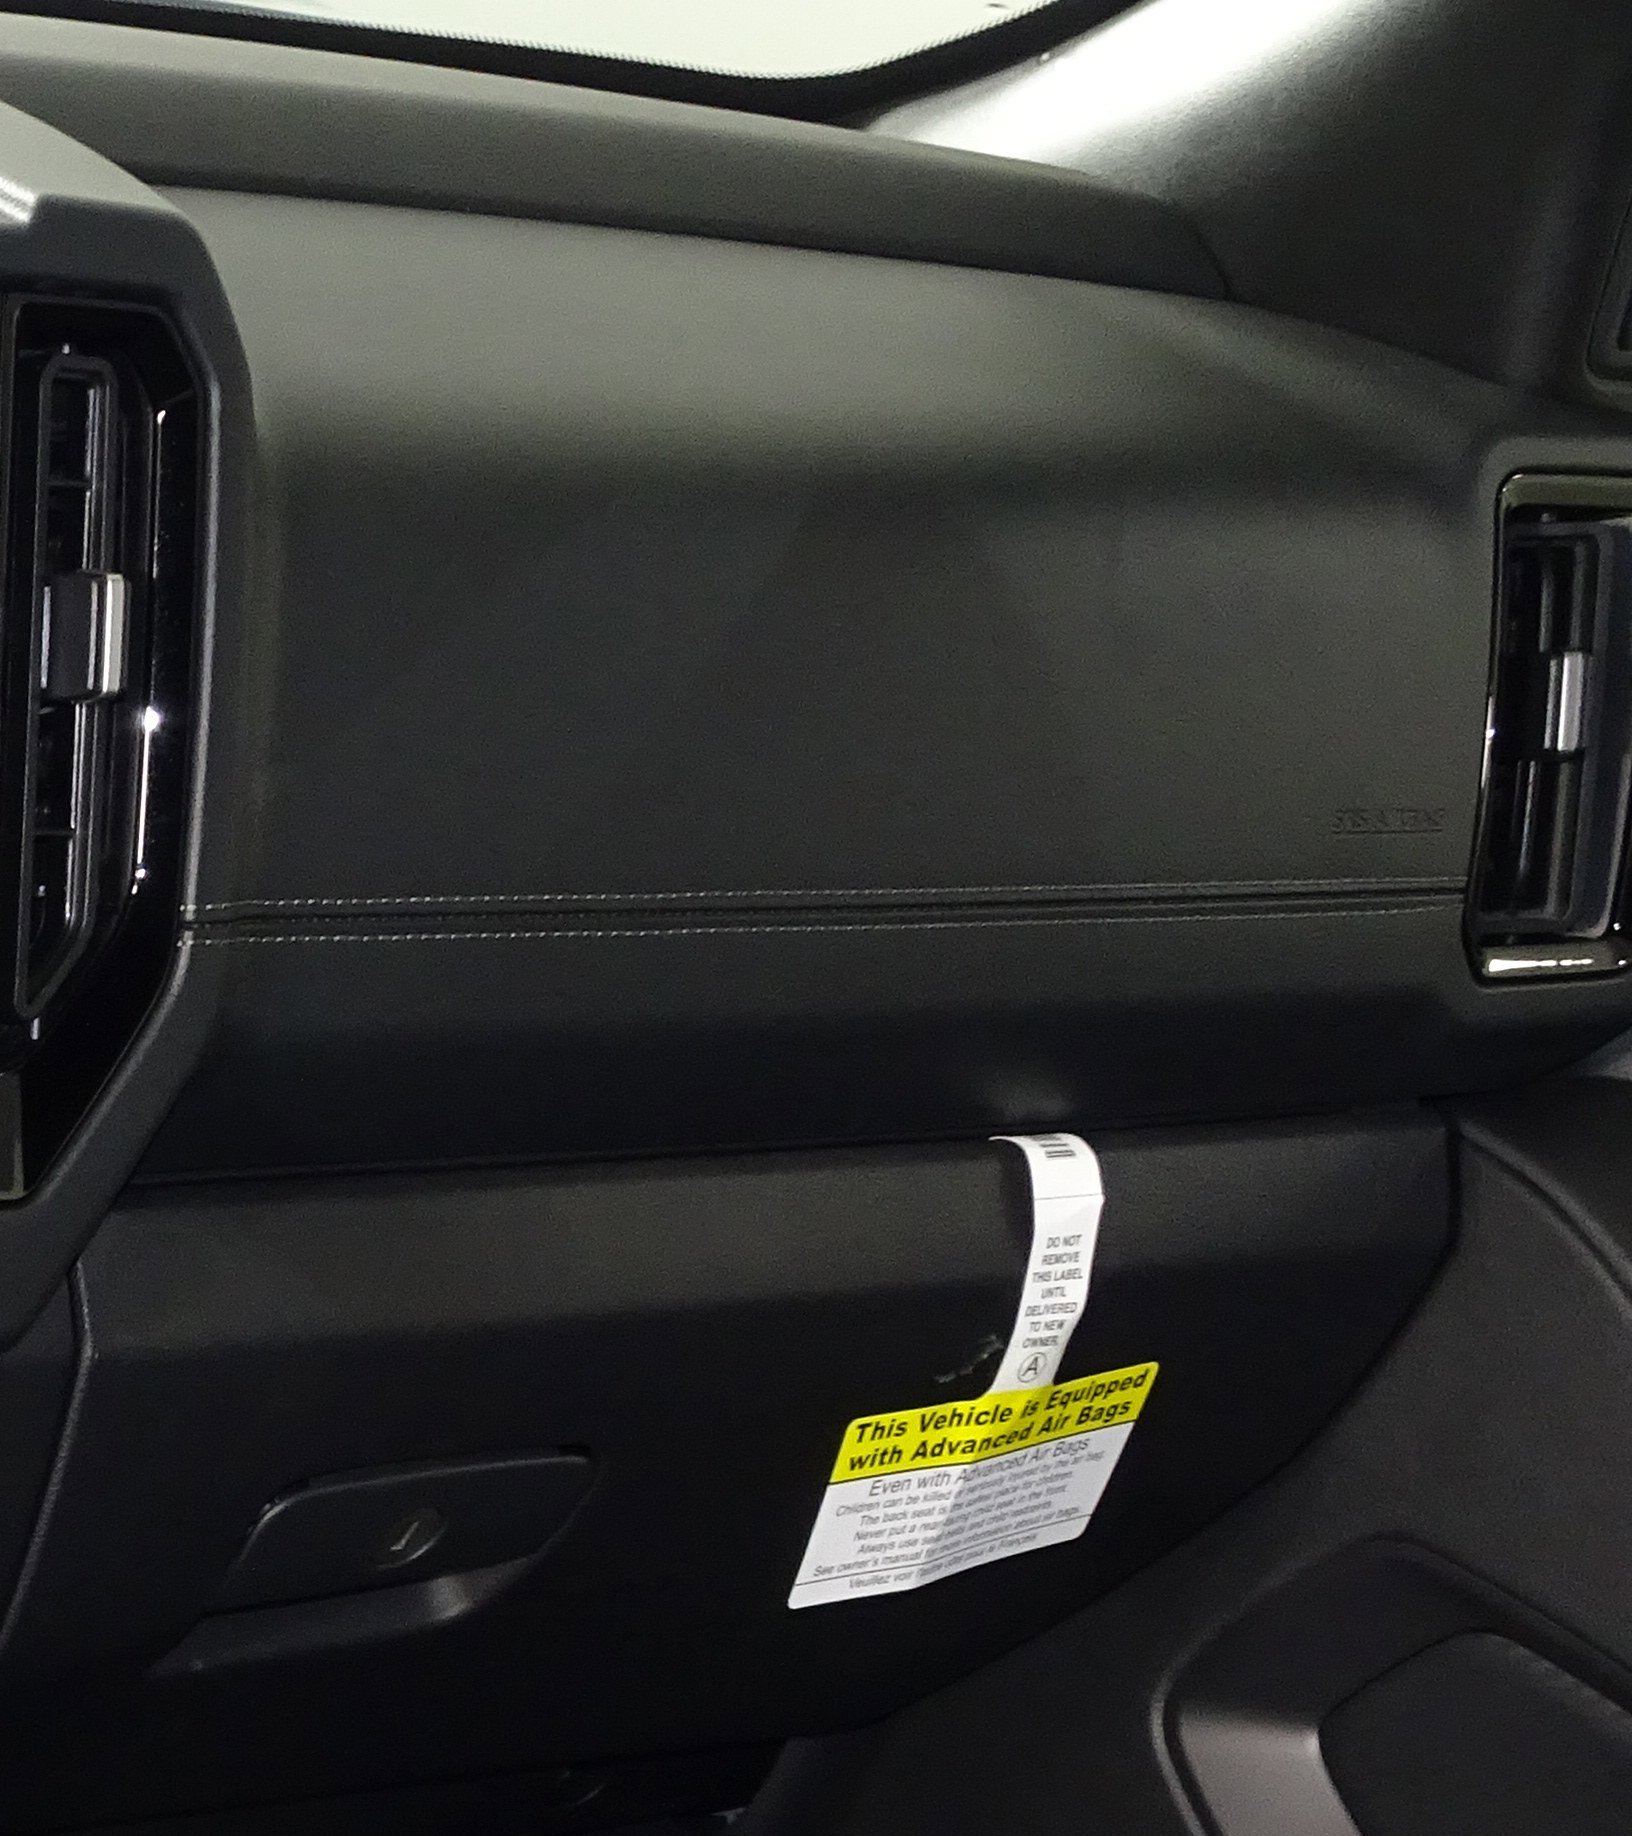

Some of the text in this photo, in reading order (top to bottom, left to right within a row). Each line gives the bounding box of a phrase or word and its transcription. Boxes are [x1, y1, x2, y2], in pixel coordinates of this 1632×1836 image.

[1046, 1234, 1083, 1249] DO NOT
[1041, 1251, 1080, 1265] REMOVE
[1054, 1268, 1083, 1281] LABEL
[856, 1368, 1150, 1444] This Vehicle is Equipped
[849, 1400, 1133, 1471] with Advanced Air Bags
[869, 1478, 912, 1496] Even
[917, 1473, 951, 1489] with
